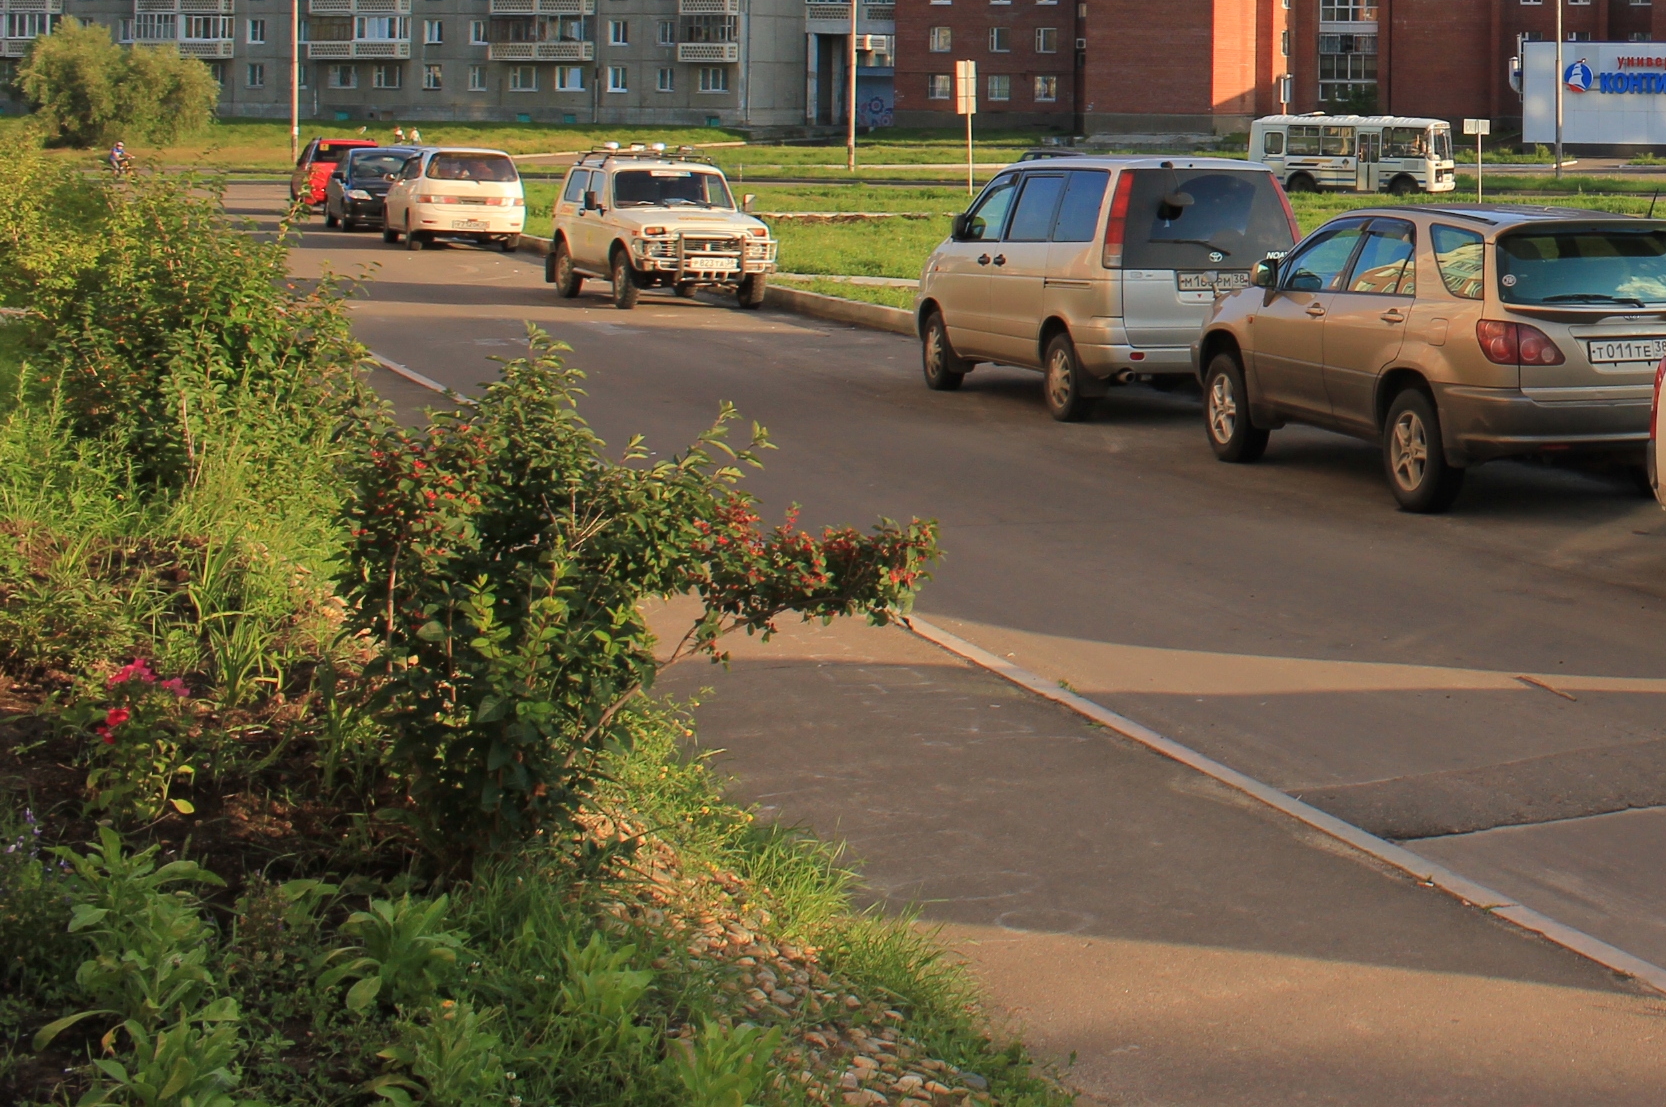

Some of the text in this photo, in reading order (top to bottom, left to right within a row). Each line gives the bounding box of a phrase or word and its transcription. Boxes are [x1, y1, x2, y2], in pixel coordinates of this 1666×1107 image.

[1266, 251, 1288, 259] NOA
[1233, 274, 1245, 283] 38
[1596, 342, 1652, 359] Т011ТЕ
